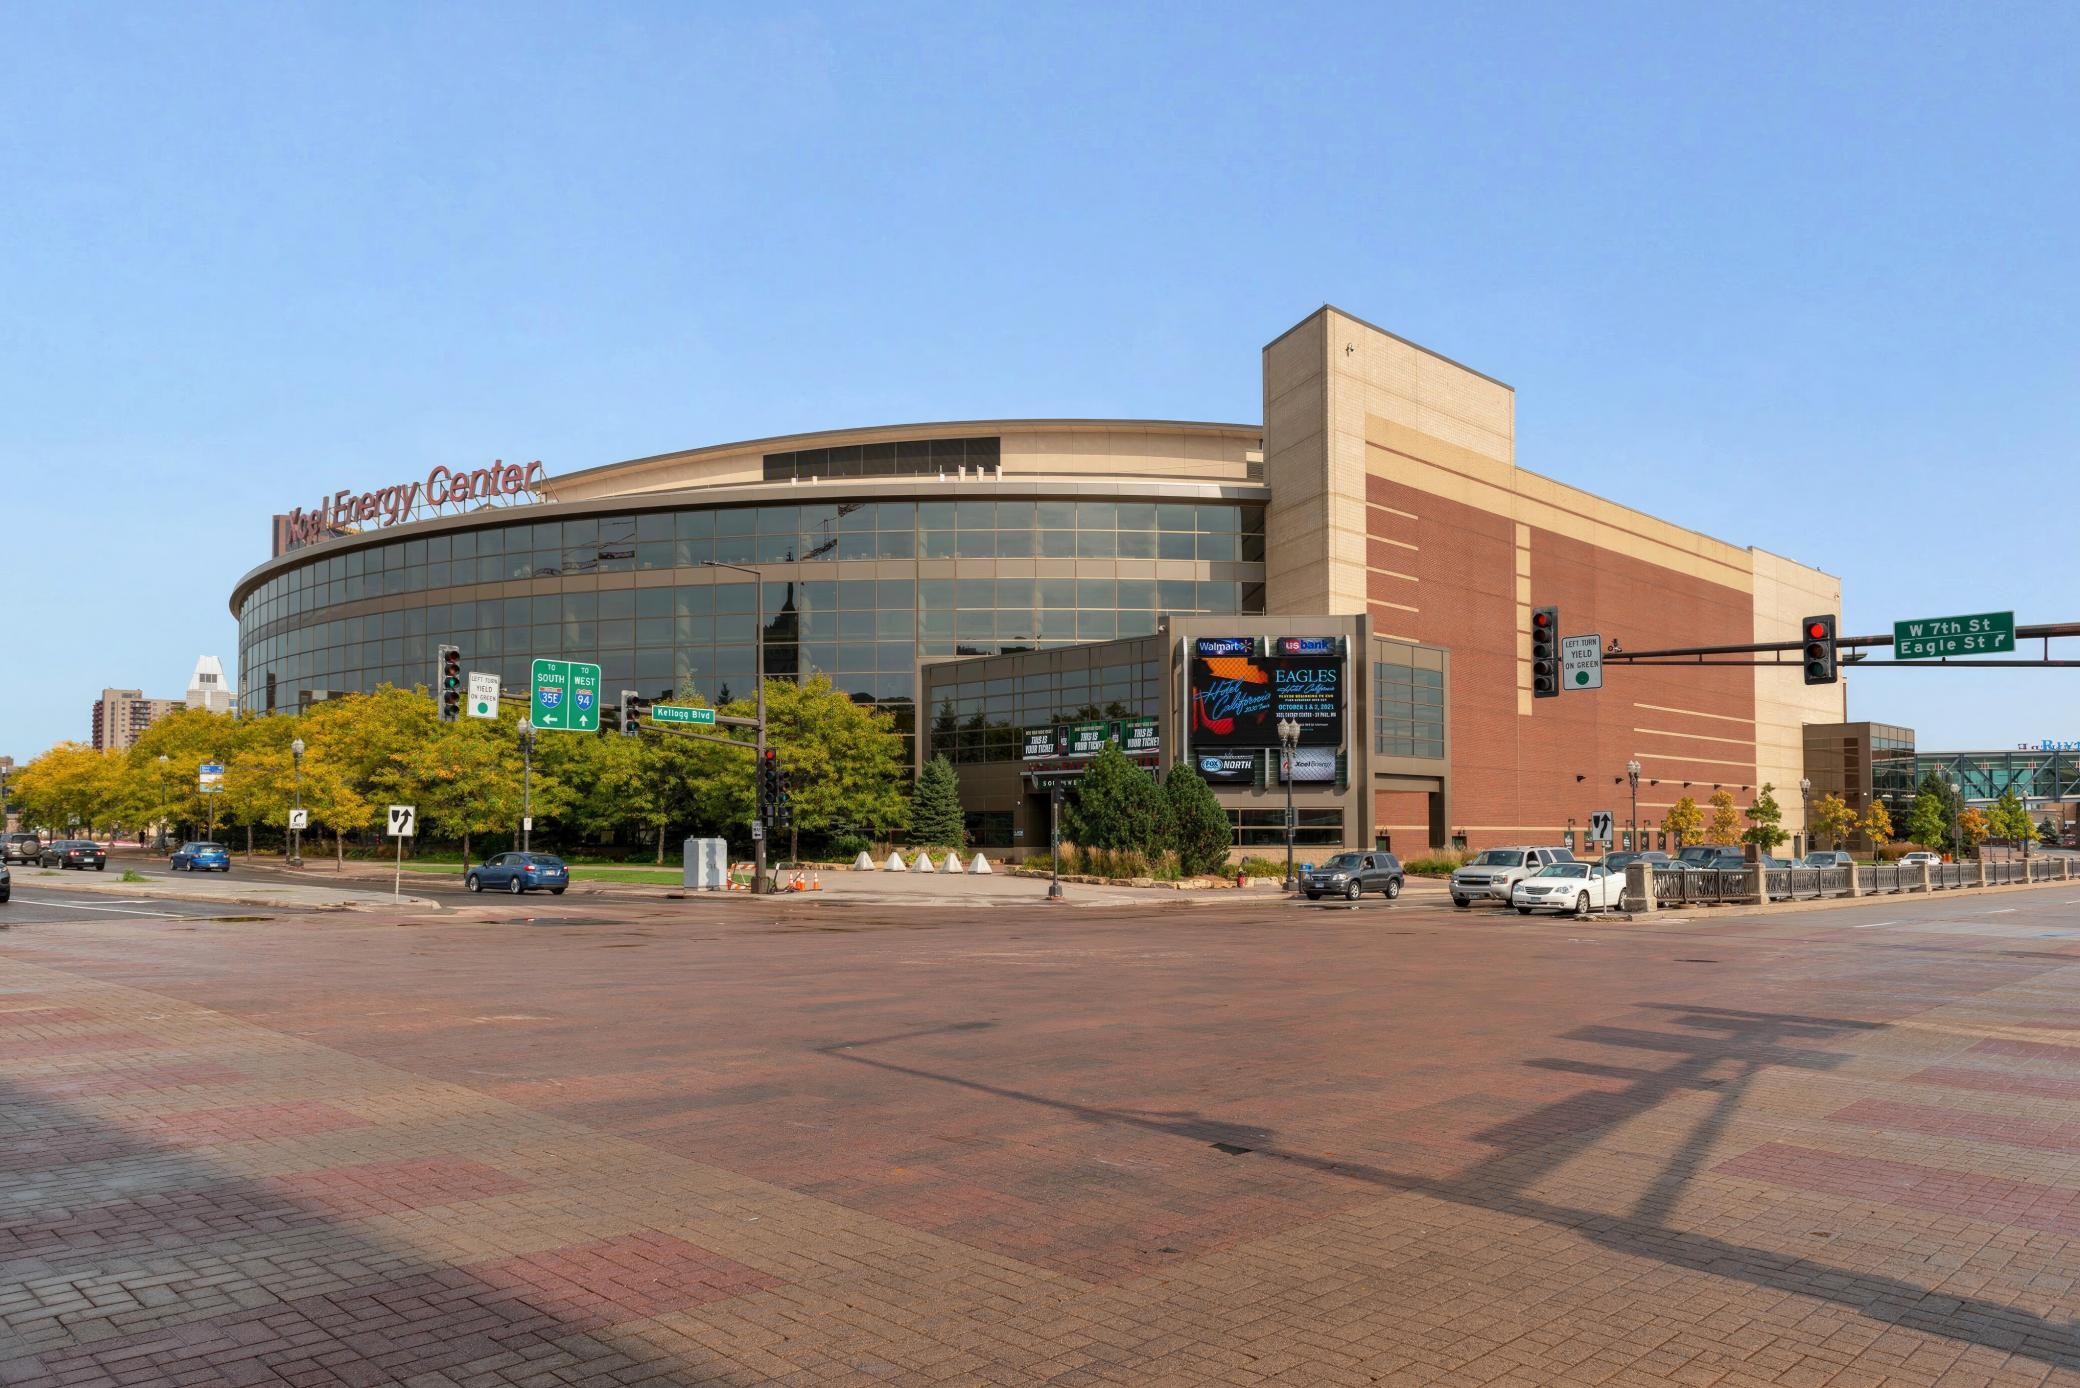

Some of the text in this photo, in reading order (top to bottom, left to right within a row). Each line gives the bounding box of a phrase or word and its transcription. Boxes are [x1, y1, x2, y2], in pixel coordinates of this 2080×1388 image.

[288, 459, 542, 544] Xcel Energy Center
[1909, 618, 1990, 637] W 7th St
[1200, 642, 1238, 651] Walmart
[1566, 640, 1578, 648] LEFT
[1901, 636, 1985, 655] Eagle St
[1571, 650, 1592, 658] YIELD
[547, 663, 556, 671] TO
[1577, 660, 1598, 669] GREEN
[538, 673, 564, 683] SOUTH
[574, 676, 595, 686] WEST
[1276, 669, 1337, 683] EAGLES
[477, 685, 492, 693] YIELD
[542, 692, 559, 704] 35E
[577, 694, 590, 706] 94
[657, 708, 710, 720] Kellogg Blvd
[1080, 731, 1099, 741] THIS IS
[1133, 728, 1153, 738] THIS IS
[1031, 735, 1048, 744] THIS IS
[1127, 738, 1141, 748] YOUR
[1142, 736, 1160, 747] TICKET
[1025, 744, 1054, 754] YOUR TICKET
[1074, 742, 1087, 751] YOUR
[1088, 741, 1104, 750] TICKET
[1223, 760, 1252, 769] NORTH
